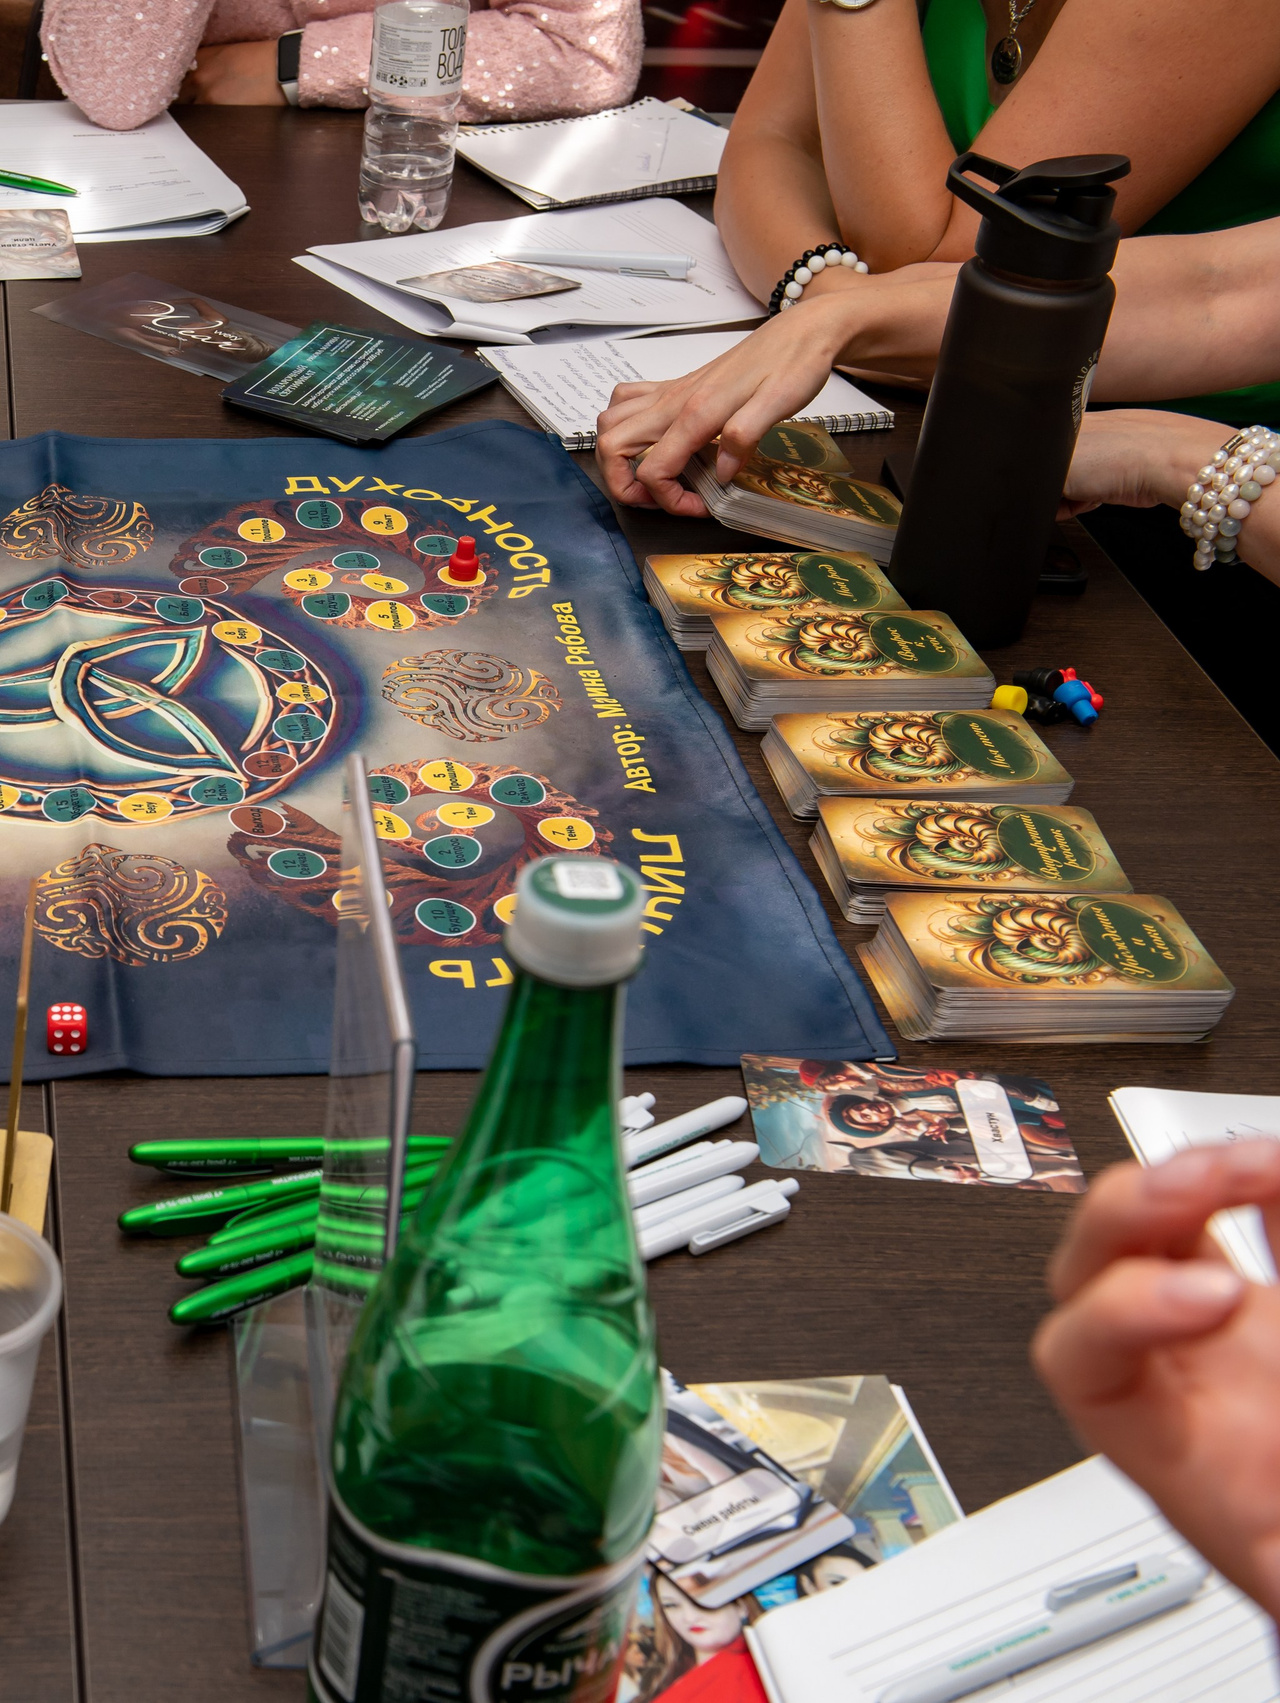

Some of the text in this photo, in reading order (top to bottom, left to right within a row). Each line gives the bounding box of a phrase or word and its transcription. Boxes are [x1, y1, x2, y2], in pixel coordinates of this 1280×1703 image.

[260, 519, 273, 542] Прошлое
[384, 514, 394, 530] Опыт
[284, 476, 552, 599] ДУХОВНОСТЬ
[308, 574, 318, 586] Опыт
[389, 602, 403, 629] Прошлое
[237, 628, 248, 639] Беру
[552, 602, 596, 666] Рябова
[887, 627, 918, 662] Вопрос
[300, 716, 312, 740] Помощь
[969, 722, 1015, 774] Моя тень
[270, 755, 281, 772] Выход
[445, 762, 461, 791] Прошлое
[216, 784, 228, 800] Блок
[516, 779, 531, 803] Сейчас
[145, 802, 157, 814] Беру
[465, 807, 478, 819] Тень
[251, 808, 265, 833] Выход
[383, 817, 395, 834] Опыт
[566, 826, 578, 841] Тень
[450, 839, 466, 863] Вопрос
[1016, 813, 1062, 880] Внутренний
[298, 853, 310, 875] Сейчас
[1091, 907, 1155, 978] Убеждения
[1141, 924, 1175, 959] блоки
[985, 1112, 1004, 1143] Хвастун
[682, 1494, 759, 1537] Смена работы
